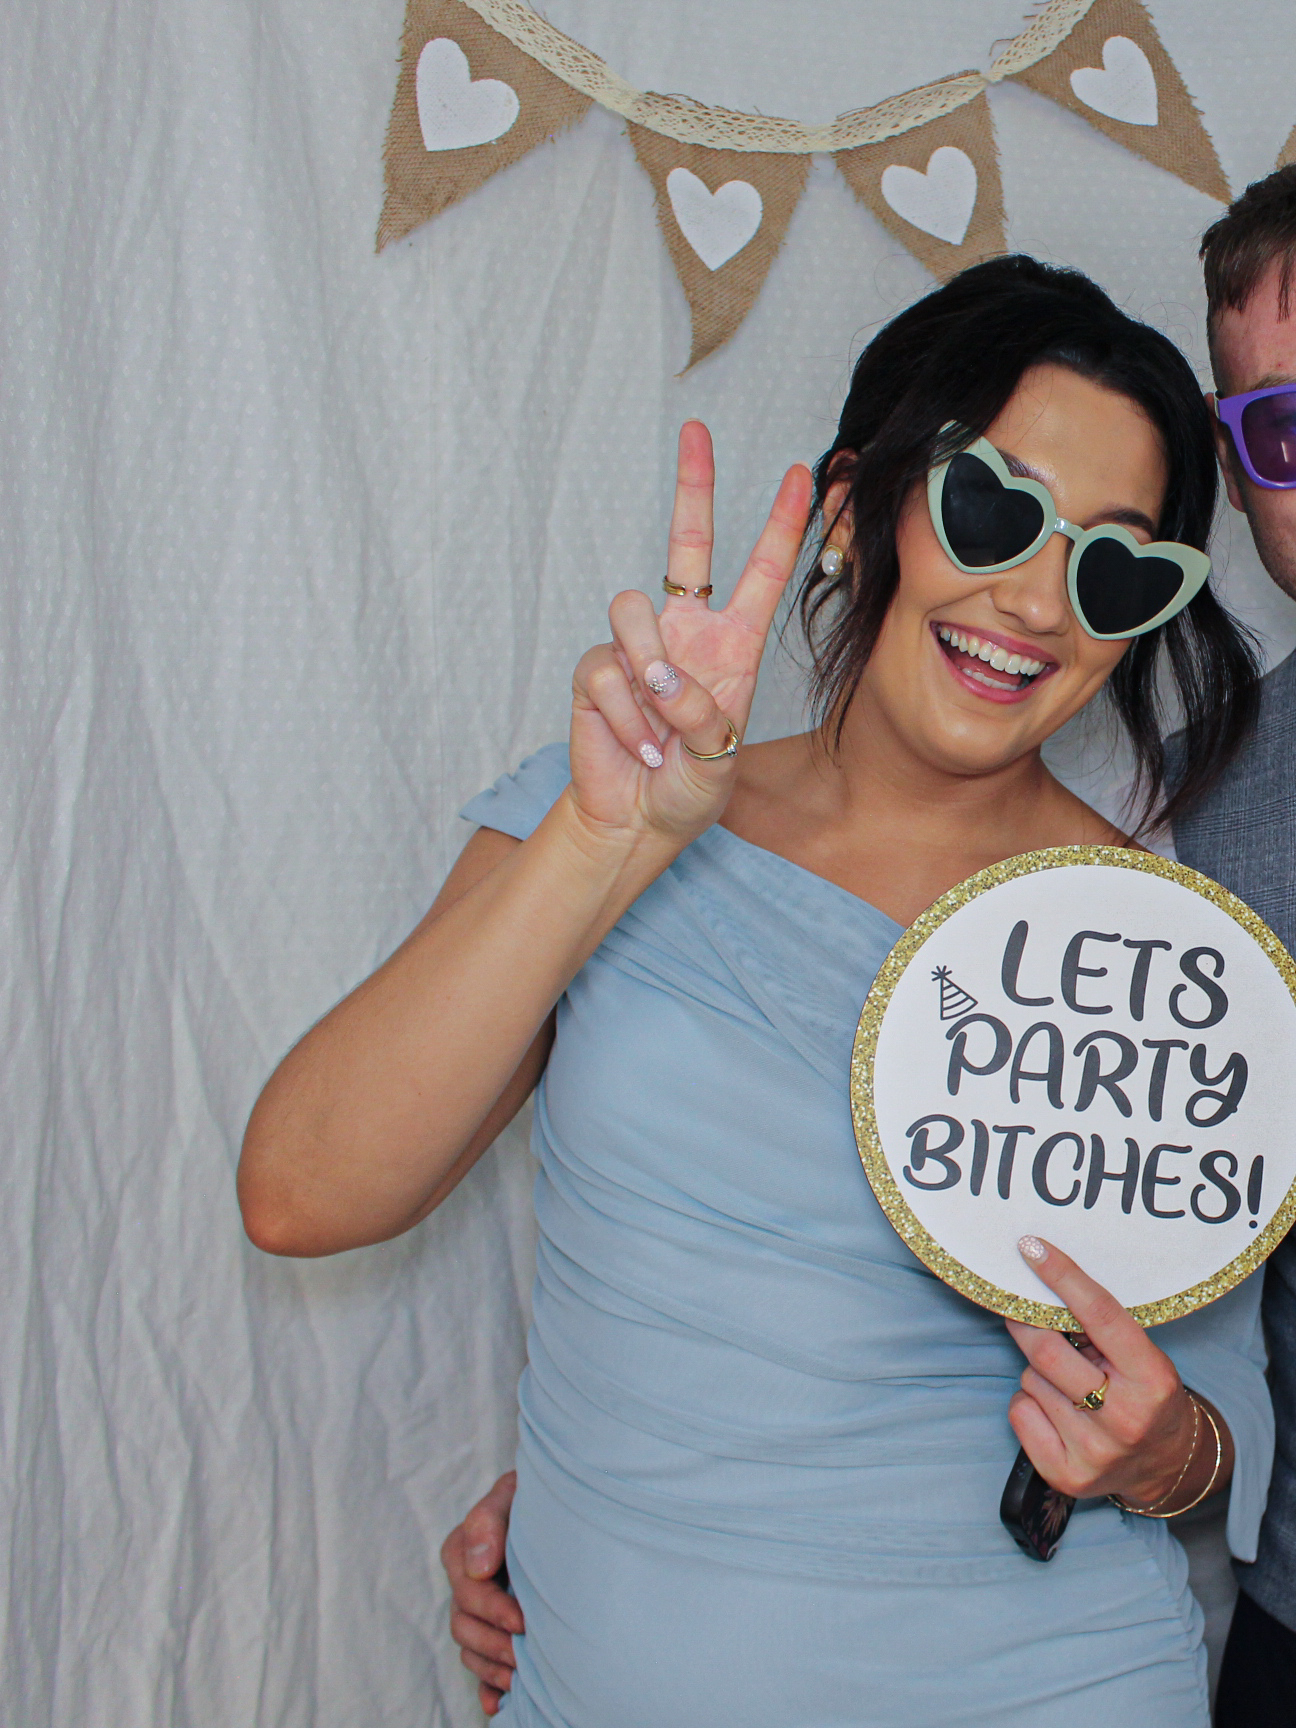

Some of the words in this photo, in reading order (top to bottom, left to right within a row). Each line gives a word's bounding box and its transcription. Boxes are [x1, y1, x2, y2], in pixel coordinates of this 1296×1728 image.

[1001, 920, 1229, 1029] LETS
[946, 1013, 1248, 1128] PARTY
[902, 1113, 1265, 1229] BITCHES!
